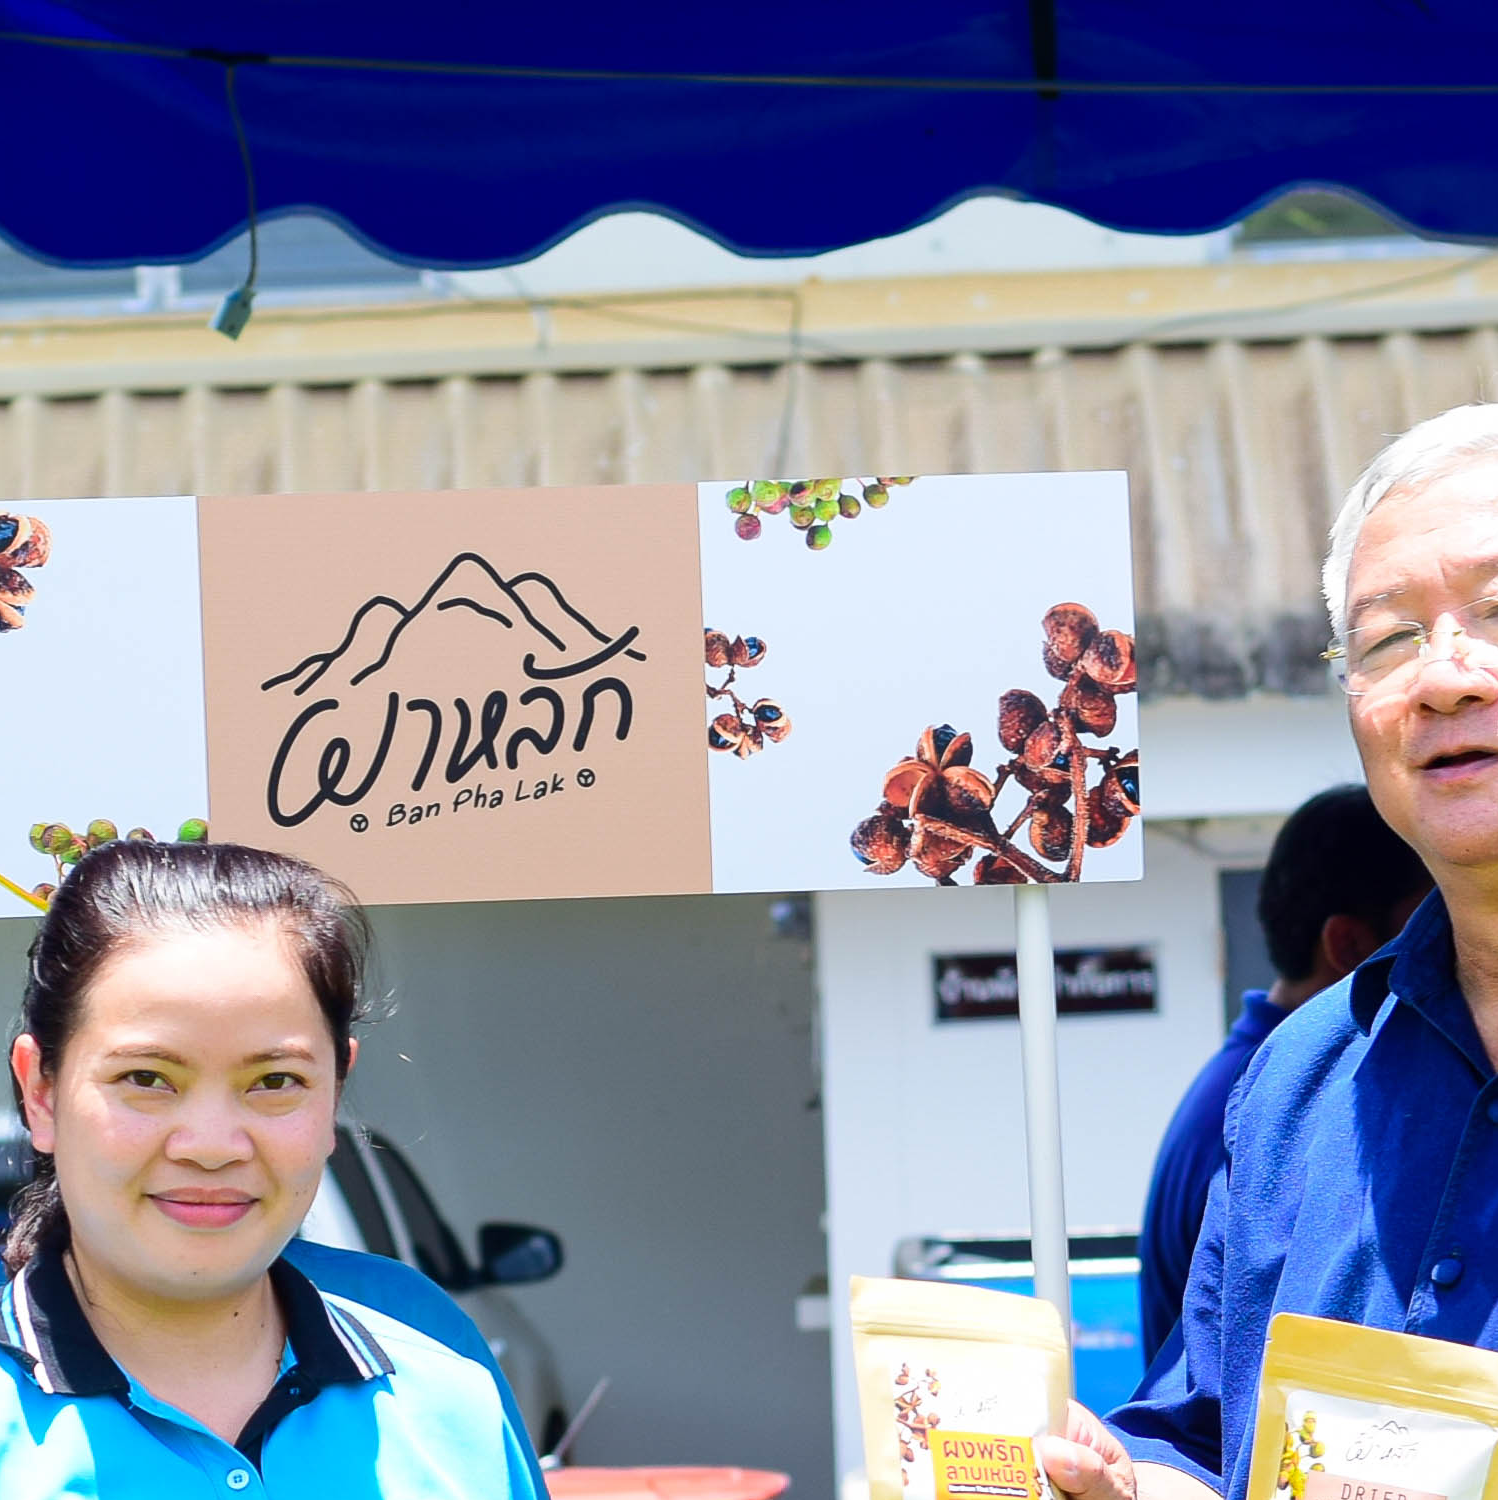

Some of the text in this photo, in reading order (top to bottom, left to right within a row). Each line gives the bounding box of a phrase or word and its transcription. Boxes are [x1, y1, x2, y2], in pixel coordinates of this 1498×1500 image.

[385, 773, 565, 827] Ban Pha Lak
[943, 1438, 1025, 1463] ผงพริก
[946, 1464, 1027, 1484] ลาบเหนือ
